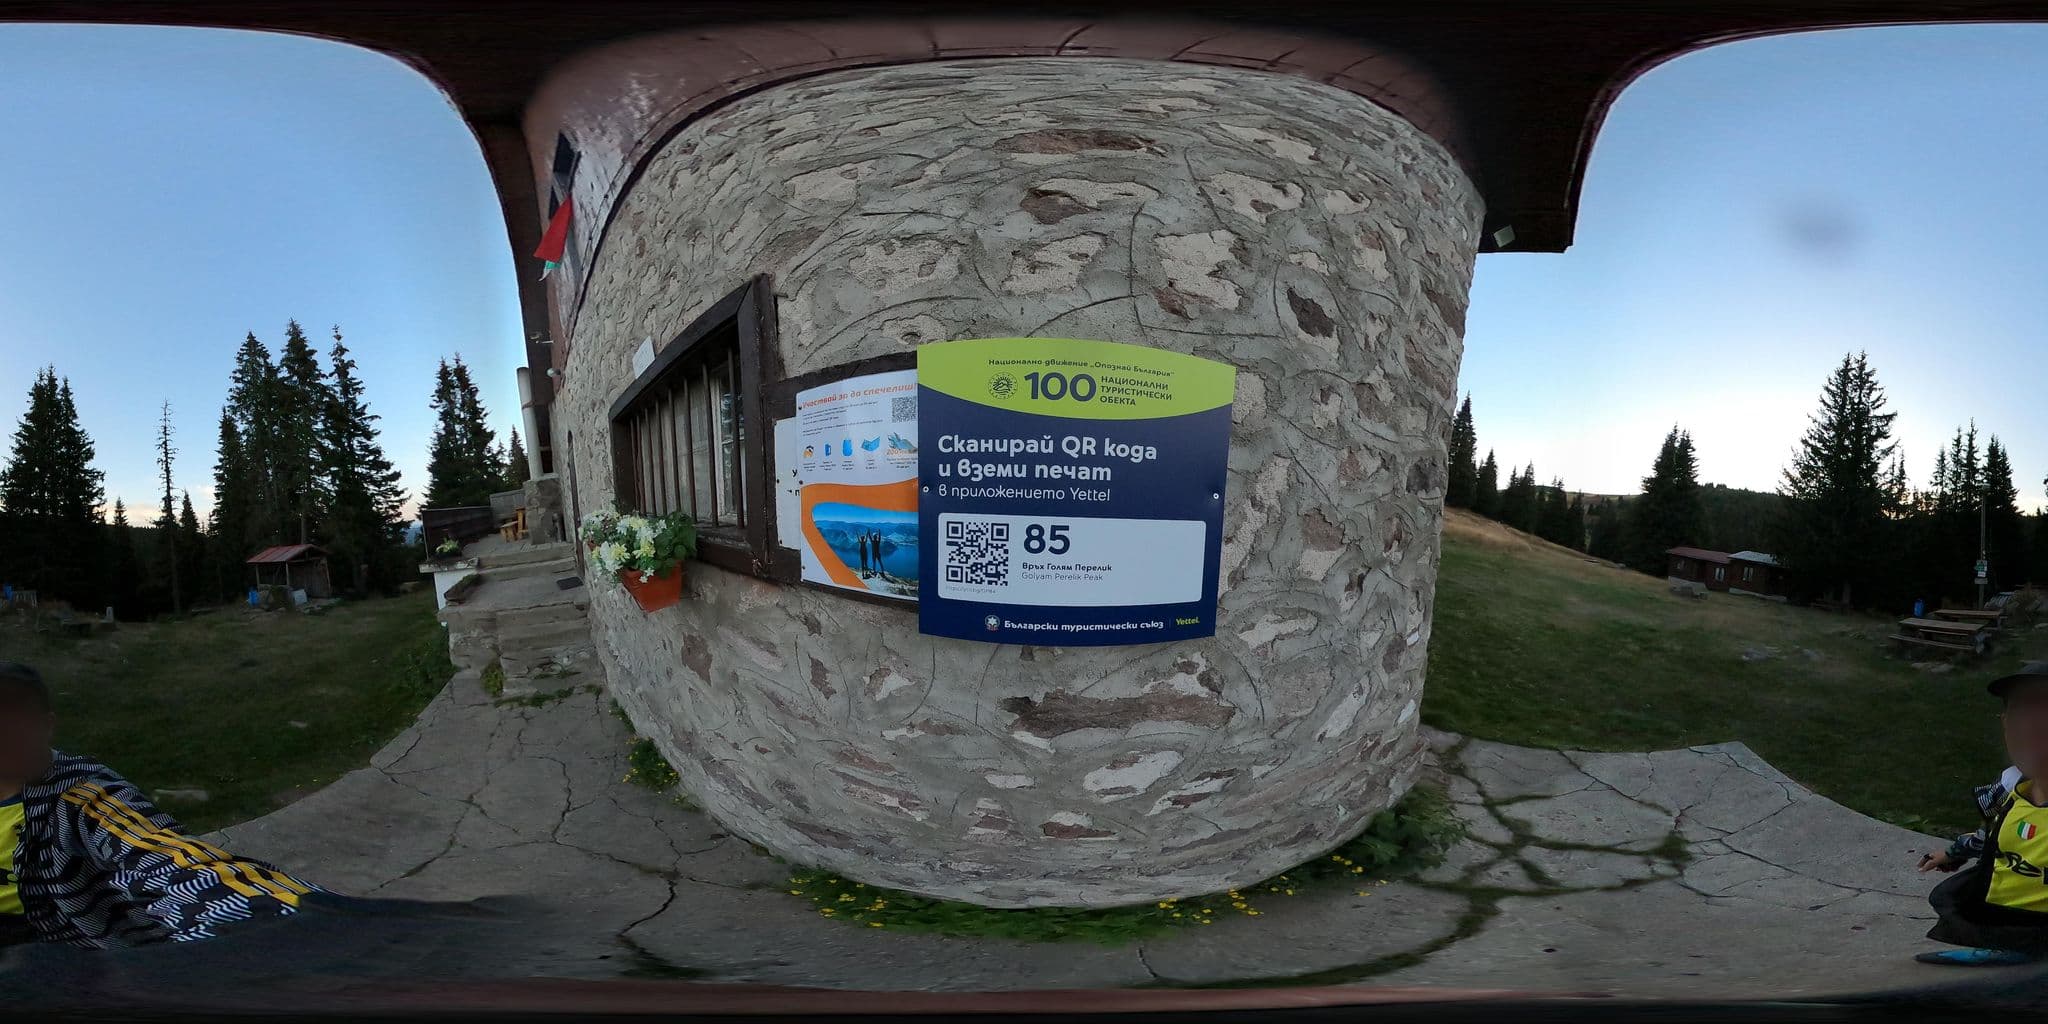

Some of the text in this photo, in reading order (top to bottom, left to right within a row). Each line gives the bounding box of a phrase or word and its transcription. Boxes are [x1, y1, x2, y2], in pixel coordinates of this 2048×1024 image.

[1044, 358, 1088, 367] движение
[1024, 372, 1097, 402] 100
[1101, 375, 1169, 391] НАЦИОНАЛНИ
[850, 390, 861, 399] да
[1100, 395, 1137, 406] ОБЕКТА
[1101, 385, 1172, 401] ТУРИСТИЧЕСКИ
[938, 434, 1157, 463] Сканирай QR кода
[938, 458, 1112, 482] и вземи печат
[938, 483, 1111, 502] в приложението Yettel
[1023, 523, 1071, 555] 85
[1022, 562, 1113, 572] Връх Голям Перелик
[1021, 571, 1053, 581] Golyam
[1004, 620, 1164, 633] Български туристически съюз
